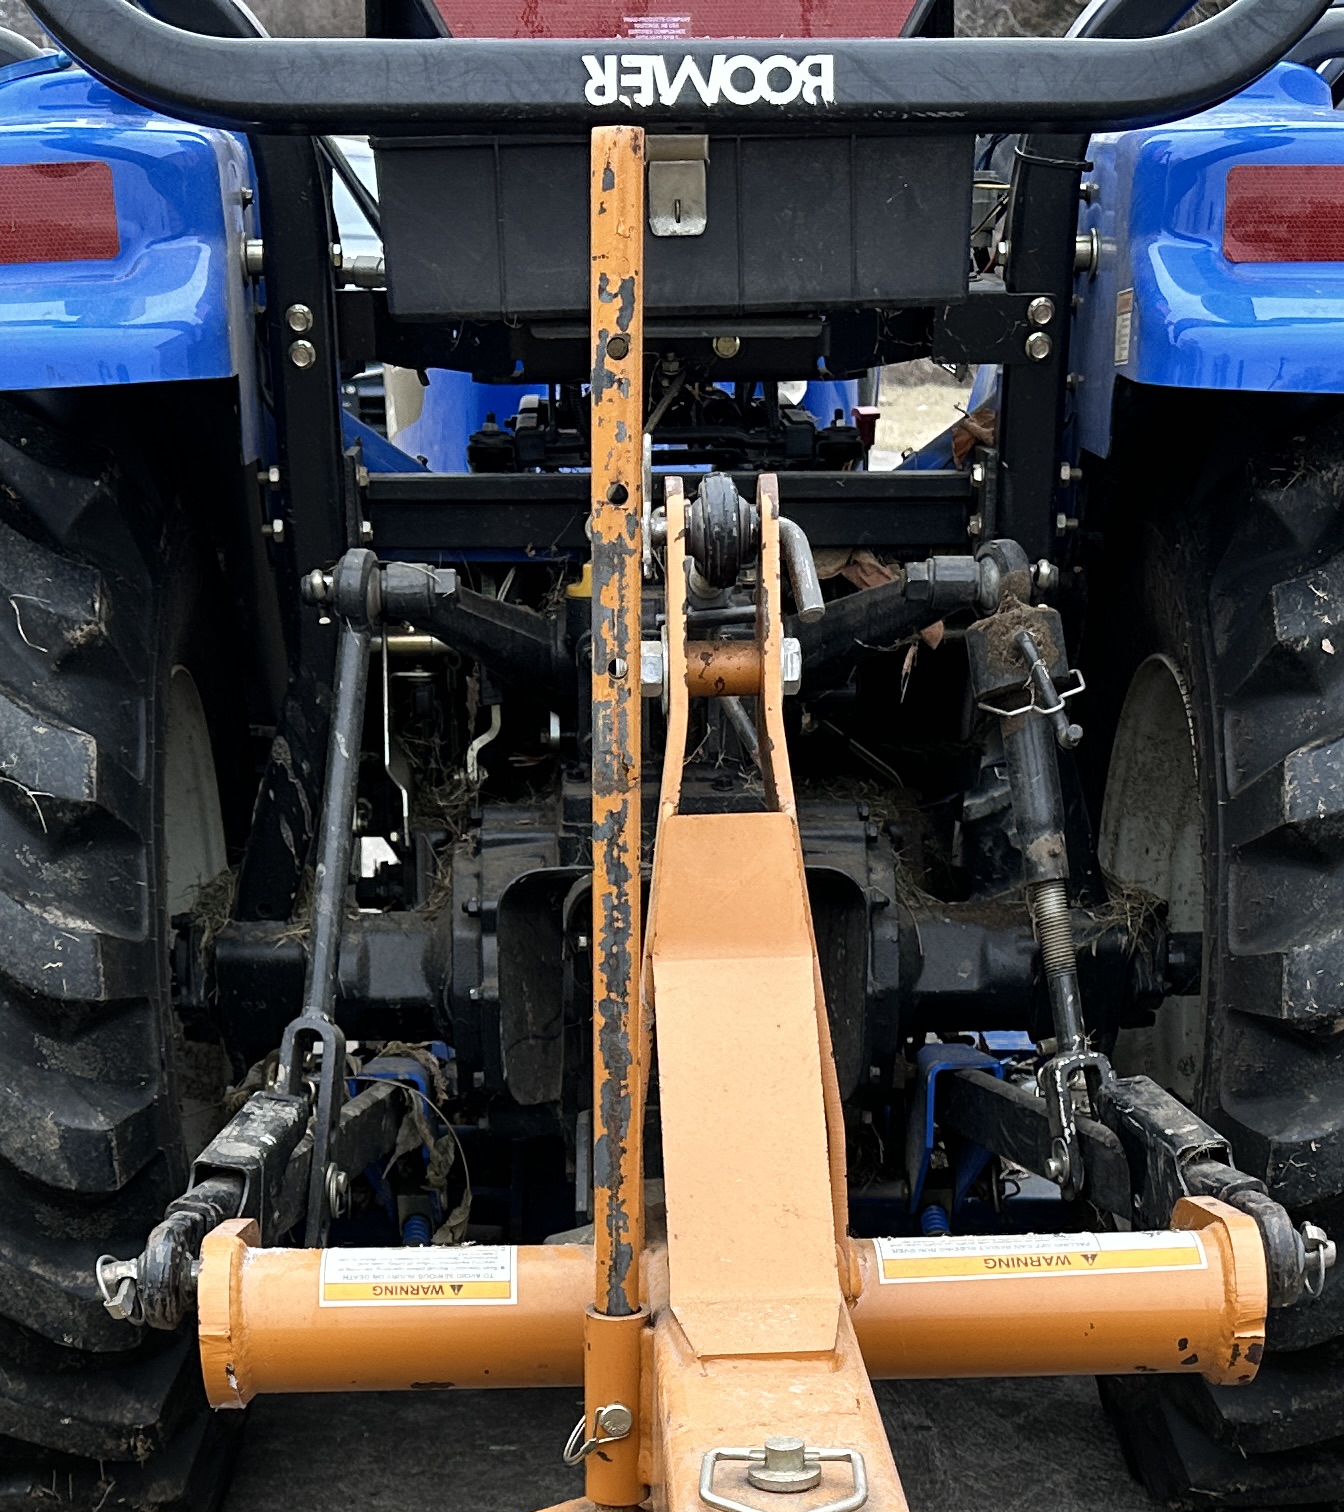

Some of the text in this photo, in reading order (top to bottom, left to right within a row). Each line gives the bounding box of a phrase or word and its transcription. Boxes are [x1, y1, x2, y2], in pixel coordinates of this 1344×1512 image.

[581, 53, 837, 107] BOOMER
[983, 1255, 1072, 1270] WARNING
[372, 1284, 445, 1296] WARNING
